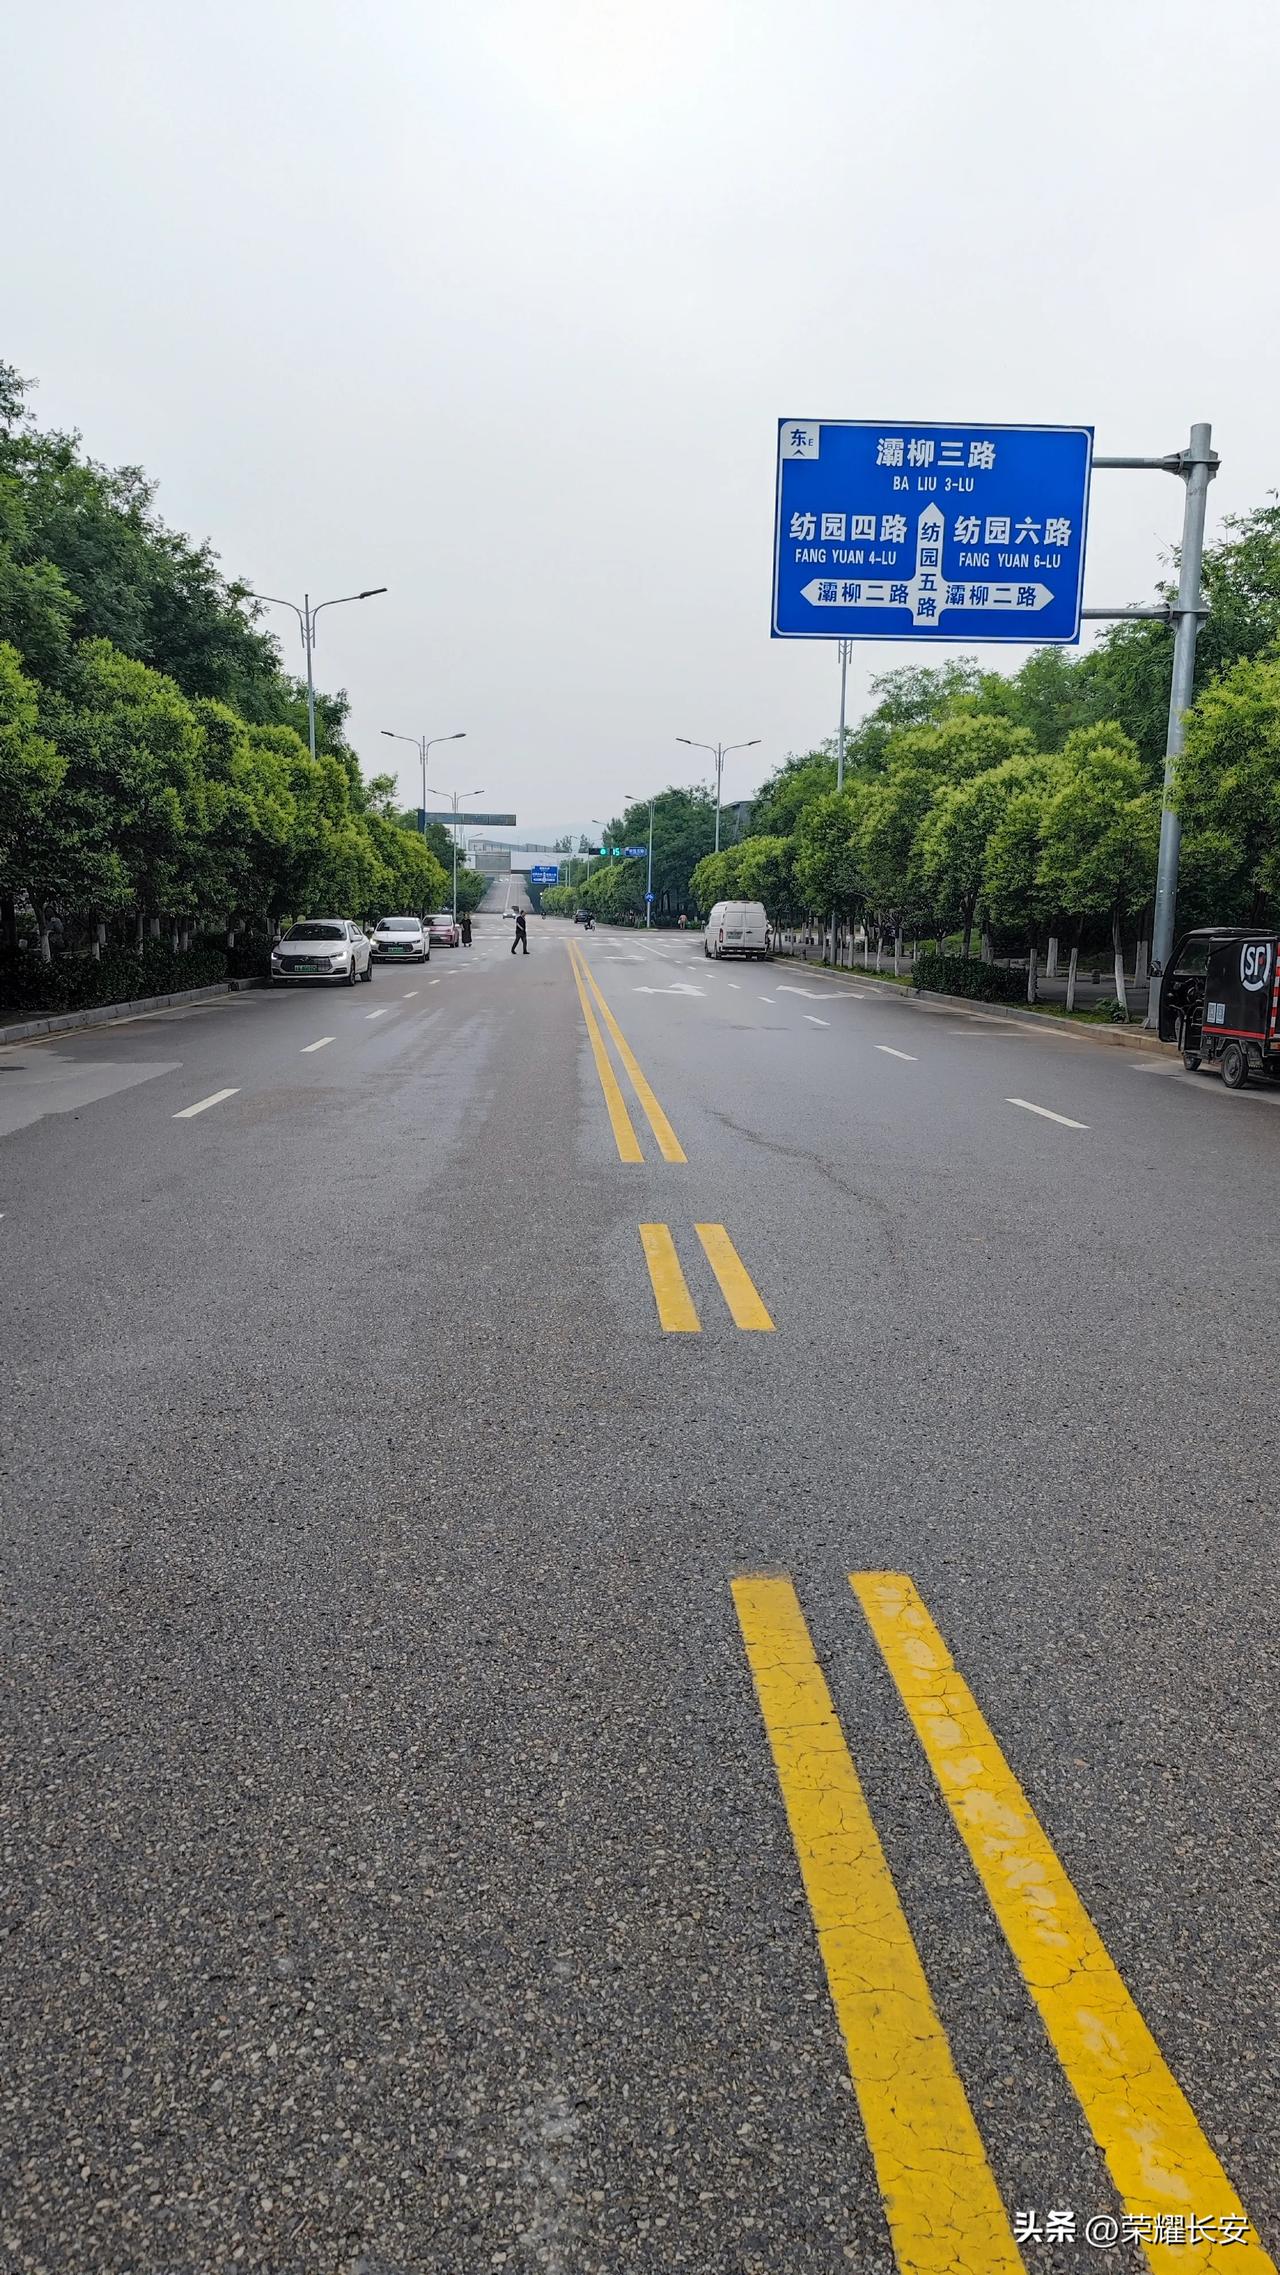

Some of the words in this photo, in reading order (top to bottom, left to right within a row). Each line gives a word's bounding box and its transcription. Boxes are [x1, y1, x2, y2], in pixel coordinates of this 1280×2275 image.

[790, 428, 807, 447] 东
[808, 438, 814, 446] E
[876, 437, 996, 470] 灞柳三路
[893, 476, 909, 491] BA
[918, 477, 937, 491] LIU
[945, 477, 974, 492] 3-LU
[789, 512, 908, 544] 纺园四路
[953, 515, 1072, 547] 纺园六路
[795, 549, 826, 564] FANG
[832, 549, 864, 565] YUAN
[868, 550, 896, 566] 4-LU
[959, 552, 989, 568] FANG
[998, 553, 1029, 568] YUAN
[1034, 554, 1061, 569] 6-LU
[917, 521, 941, 618] 纺园五路
[817, 581, 909, 605] 灞柳二路
[945, 584, 1037, 607] 灞柳二路
